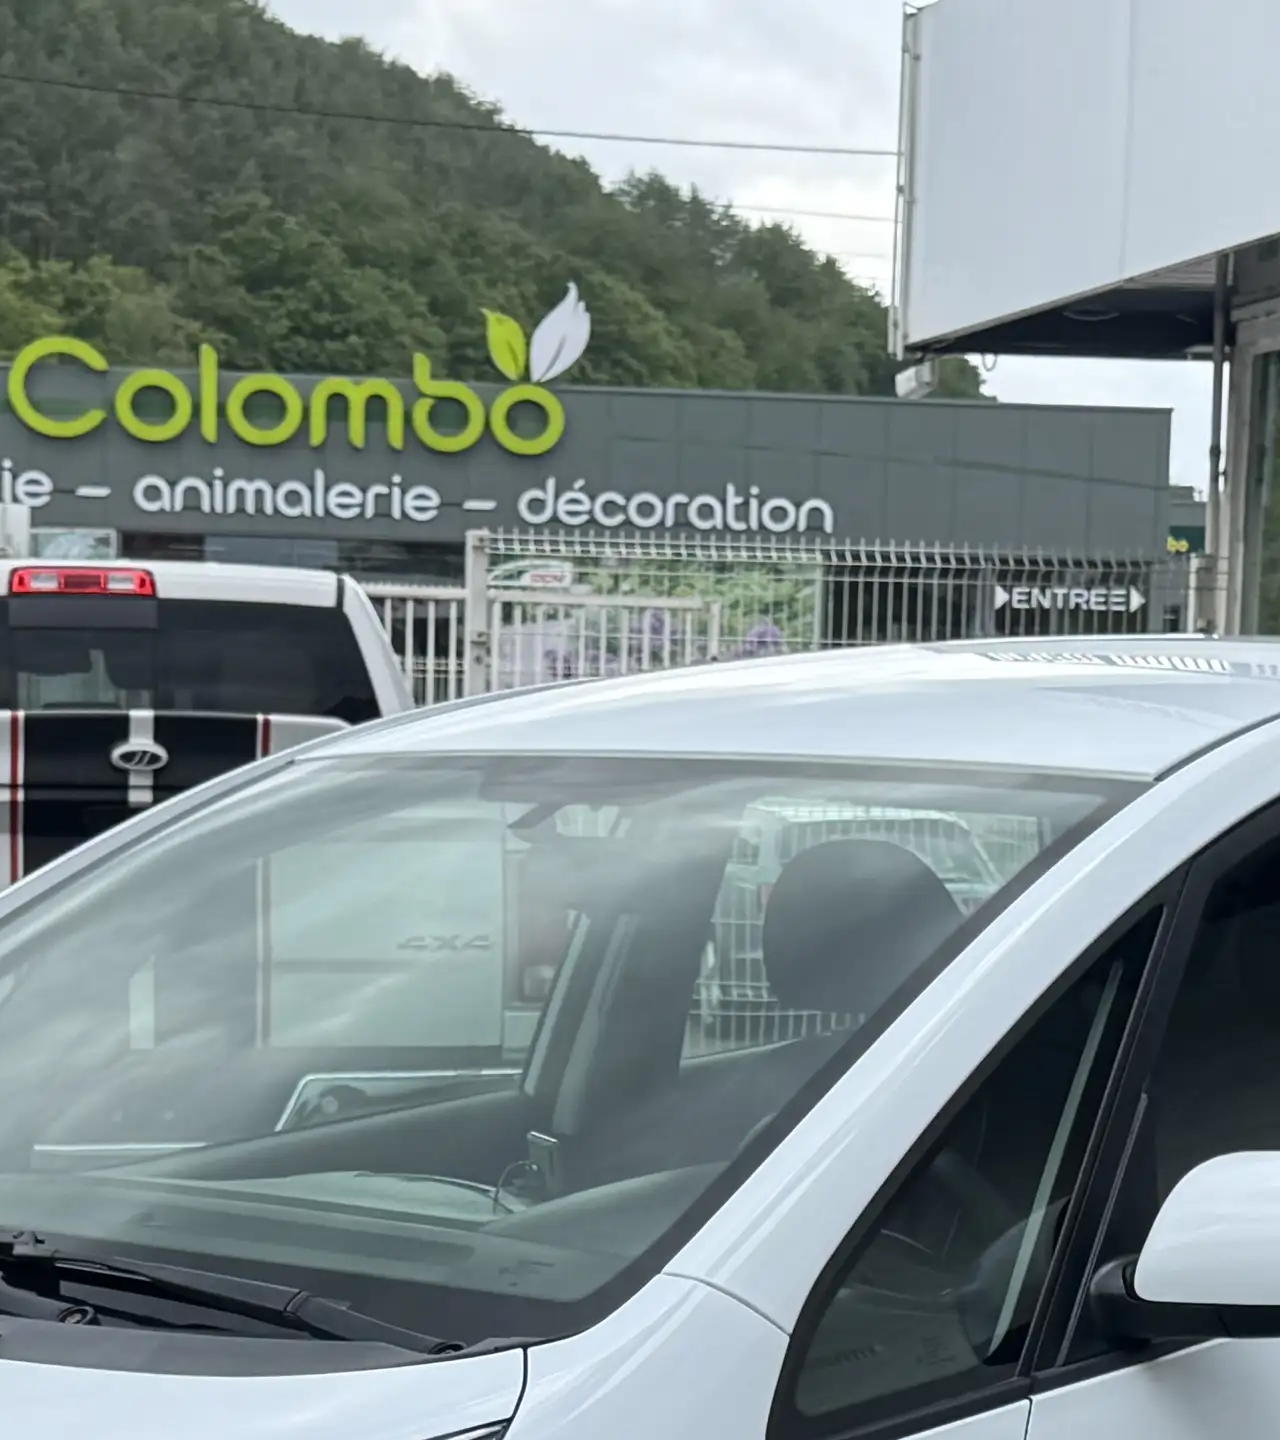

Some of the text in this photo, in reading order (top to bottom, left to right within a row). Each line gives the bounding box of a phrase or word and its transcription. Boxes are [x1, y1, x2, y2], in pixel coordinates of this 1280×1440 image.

[8, 335, 565, 456] Colombo
[132, 466, 441, 522] animalerie
[517, 478, 835, 534] décoration
[1010, 585, 1129, 612] ENTREE
